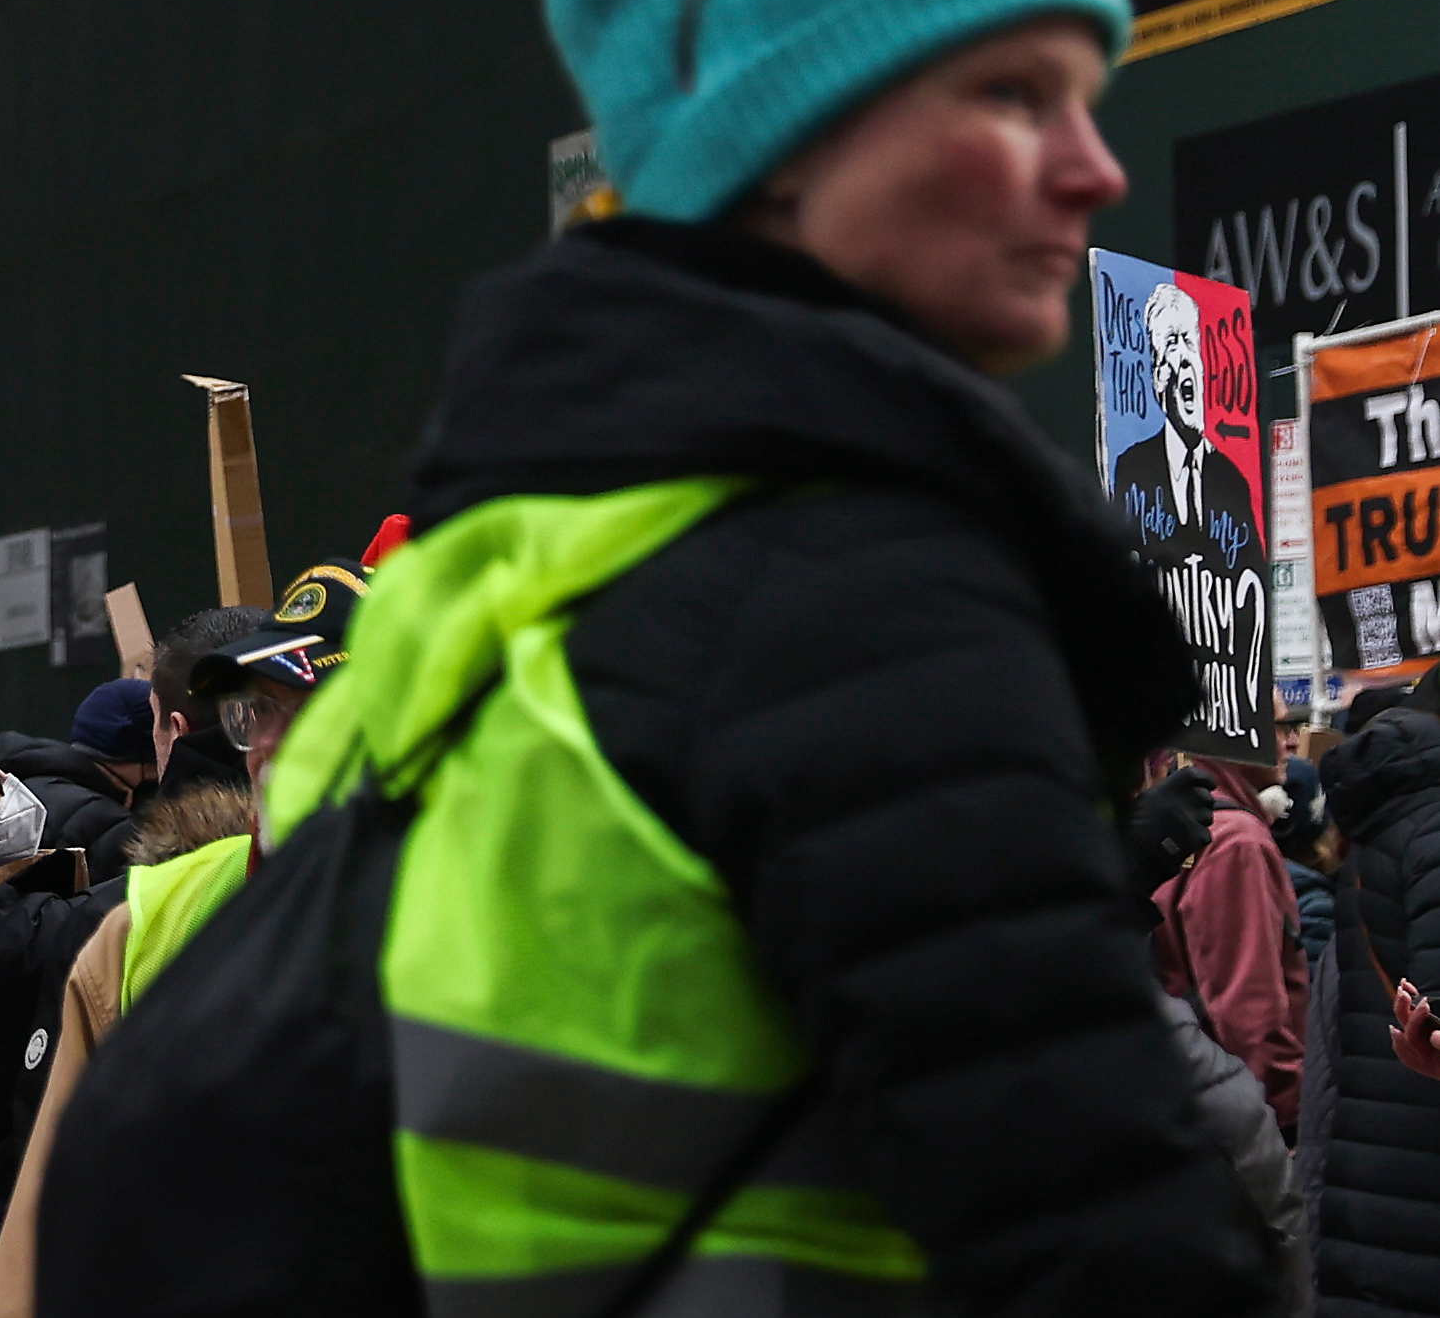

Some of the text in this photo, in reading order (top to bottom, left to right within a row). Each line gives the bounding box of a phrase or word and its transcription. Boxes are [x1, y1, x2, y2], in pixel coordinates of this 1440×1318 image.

[1204, 180, 1381, 310] AW&S
[1100, 270, 1145, 355] DOES
[1109, 350, 1147, 420] THIS
[1204, 307, 1253, 416] ASS
[1363, 382, 1440, 469] Th
[1124, 482, 1176, 546] Make
[1325, 485, 1440, 573] TRU
